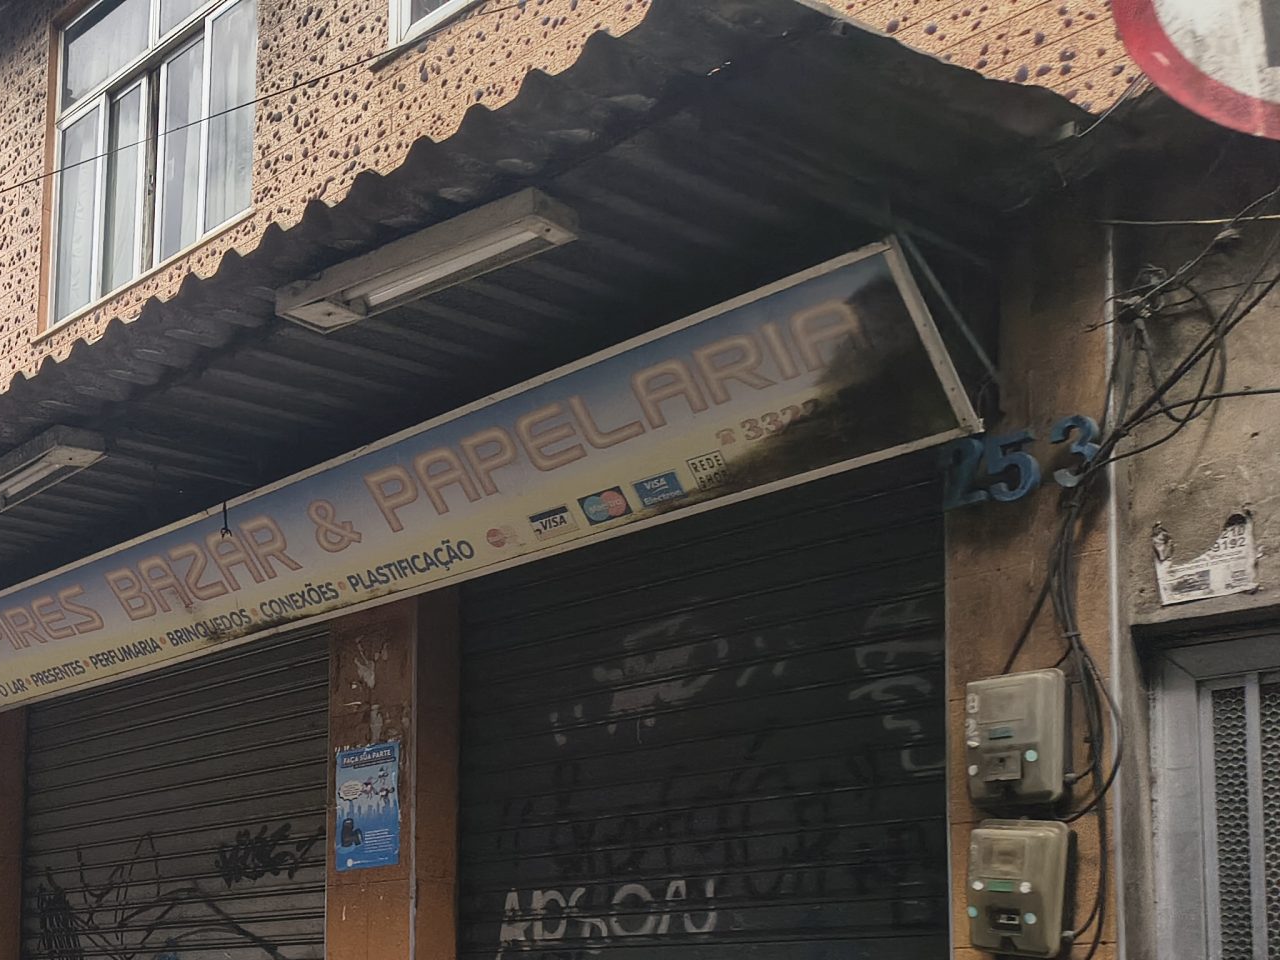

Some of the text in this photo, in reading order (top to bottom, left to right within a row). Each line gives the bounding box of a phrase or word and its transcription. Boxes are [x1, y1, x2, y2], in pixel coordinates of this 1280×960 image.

[104, 514, 303, 621] BAZAR
[307, 499, 363, 553] &
[363, 299, 862, 532] PAPELARIA
[643, 477, 668, 490] VISA
[691, 455, 722, 473] REDE
[943, 415, 1101, 512] 253
[539, 515, 568, 532] VISA
[0, 684, 9, 697] O
[6, 678, 29, 695] LAR
[30, 660, 86, 687] PRESENTES
[89, 637, 163, 670] PERFUMARIA
[166, 608, 253, 648] BRINQUEDOS
[259, 582, 340, 618] CONEXÕES
[347, 539, 475, 592] PLASTIFICAÇÃO
